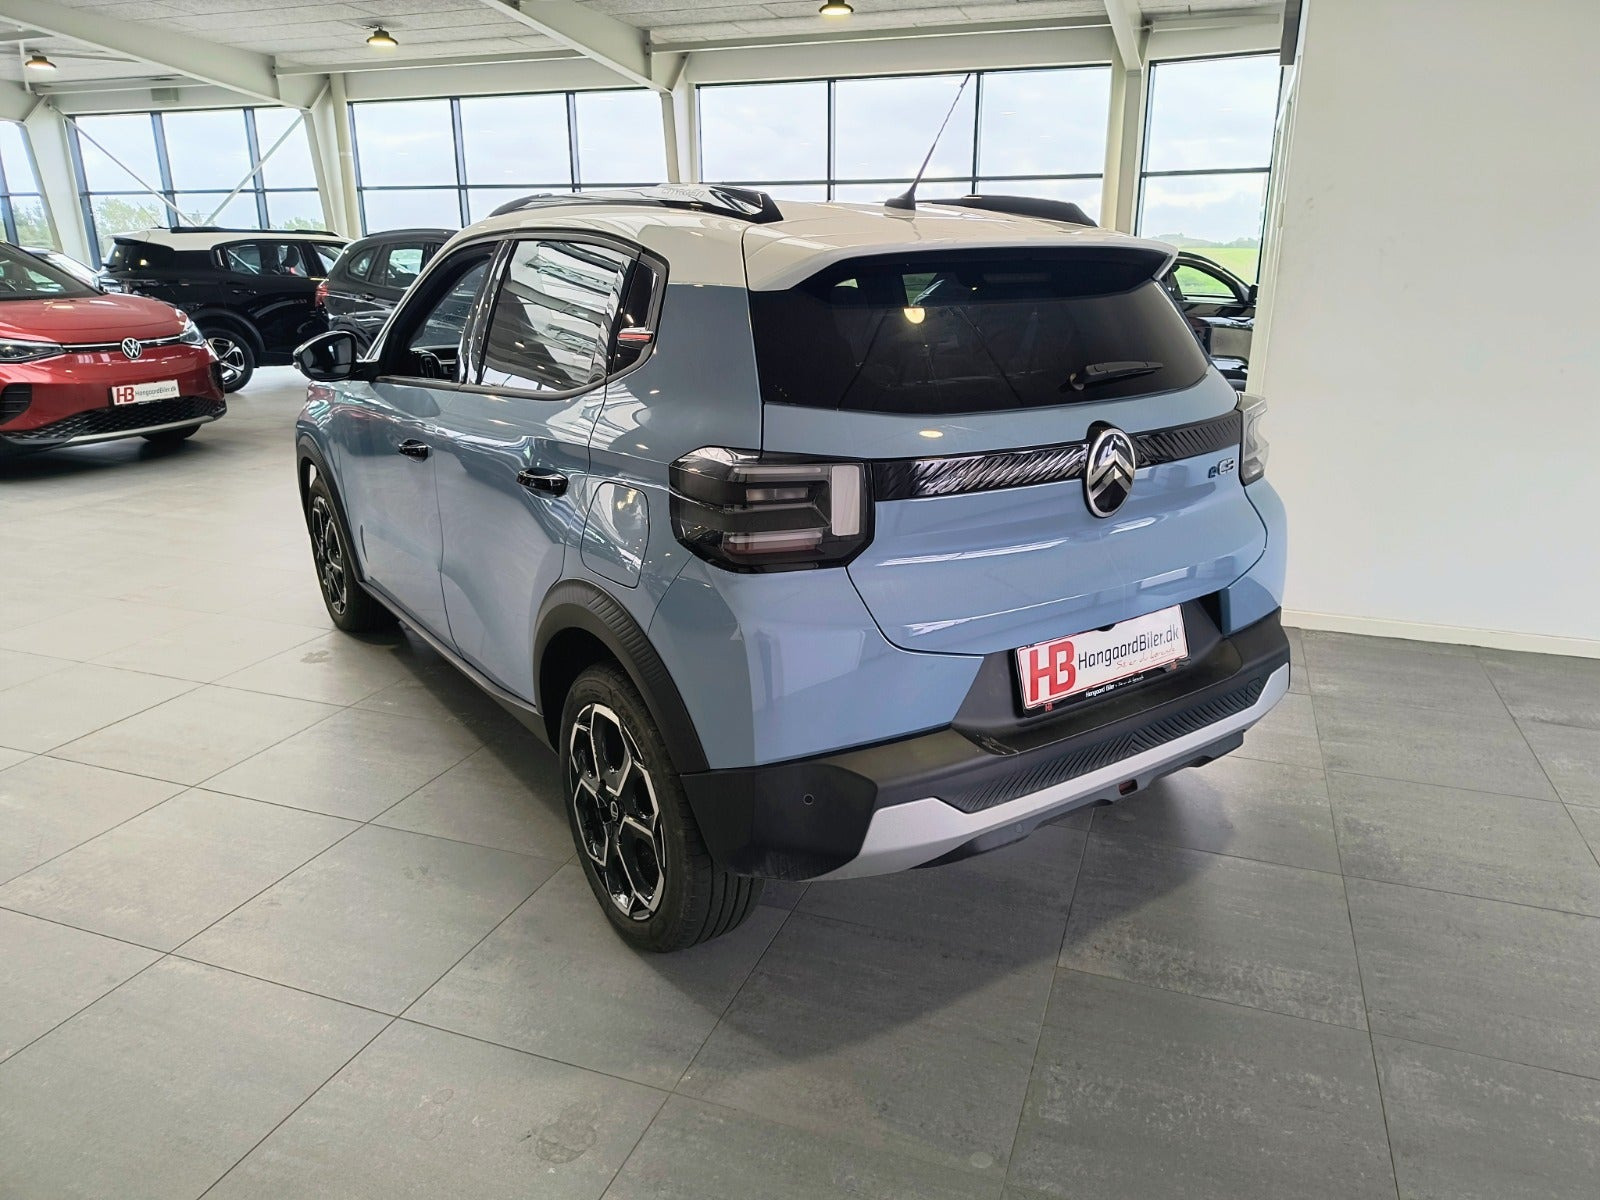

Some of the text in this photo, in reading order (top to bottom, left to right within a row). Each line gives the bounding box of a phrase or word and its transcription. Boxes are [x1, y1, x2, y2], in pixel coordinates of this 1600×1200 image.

[116, 387, 135, 403] HB
[1029, 624, 1180, 702] HB HangaardBiler.dk
